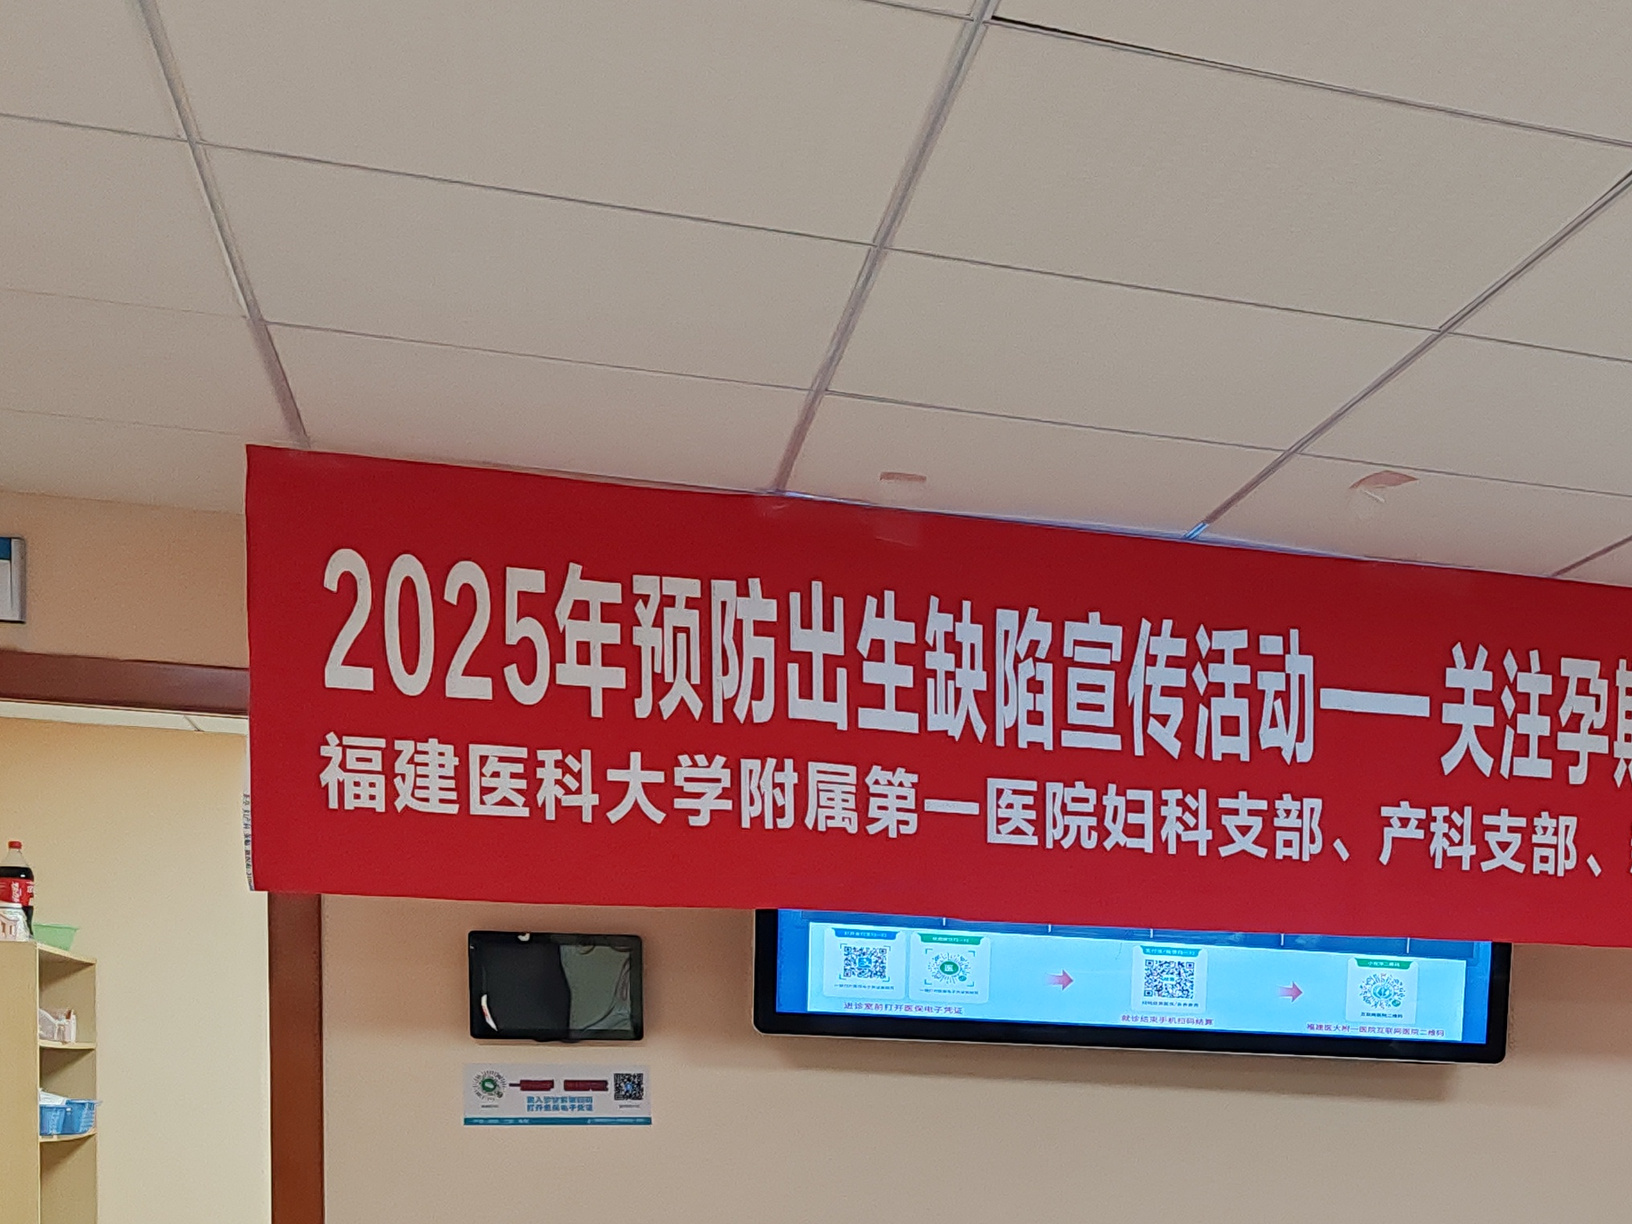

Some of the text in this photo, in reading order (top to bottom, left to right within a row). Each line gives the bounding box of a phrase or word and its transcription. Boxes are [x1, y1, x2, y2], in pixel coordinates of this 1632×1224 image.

[843, 1001, 963, 1015] 进诊室前打开医保电子凭证
[1121, 1014, 1213, 1026] 就诊结束手机扫码结算
[1306, 1023, 1445, 1037] 福建医大附一医院互联网医院二维码
